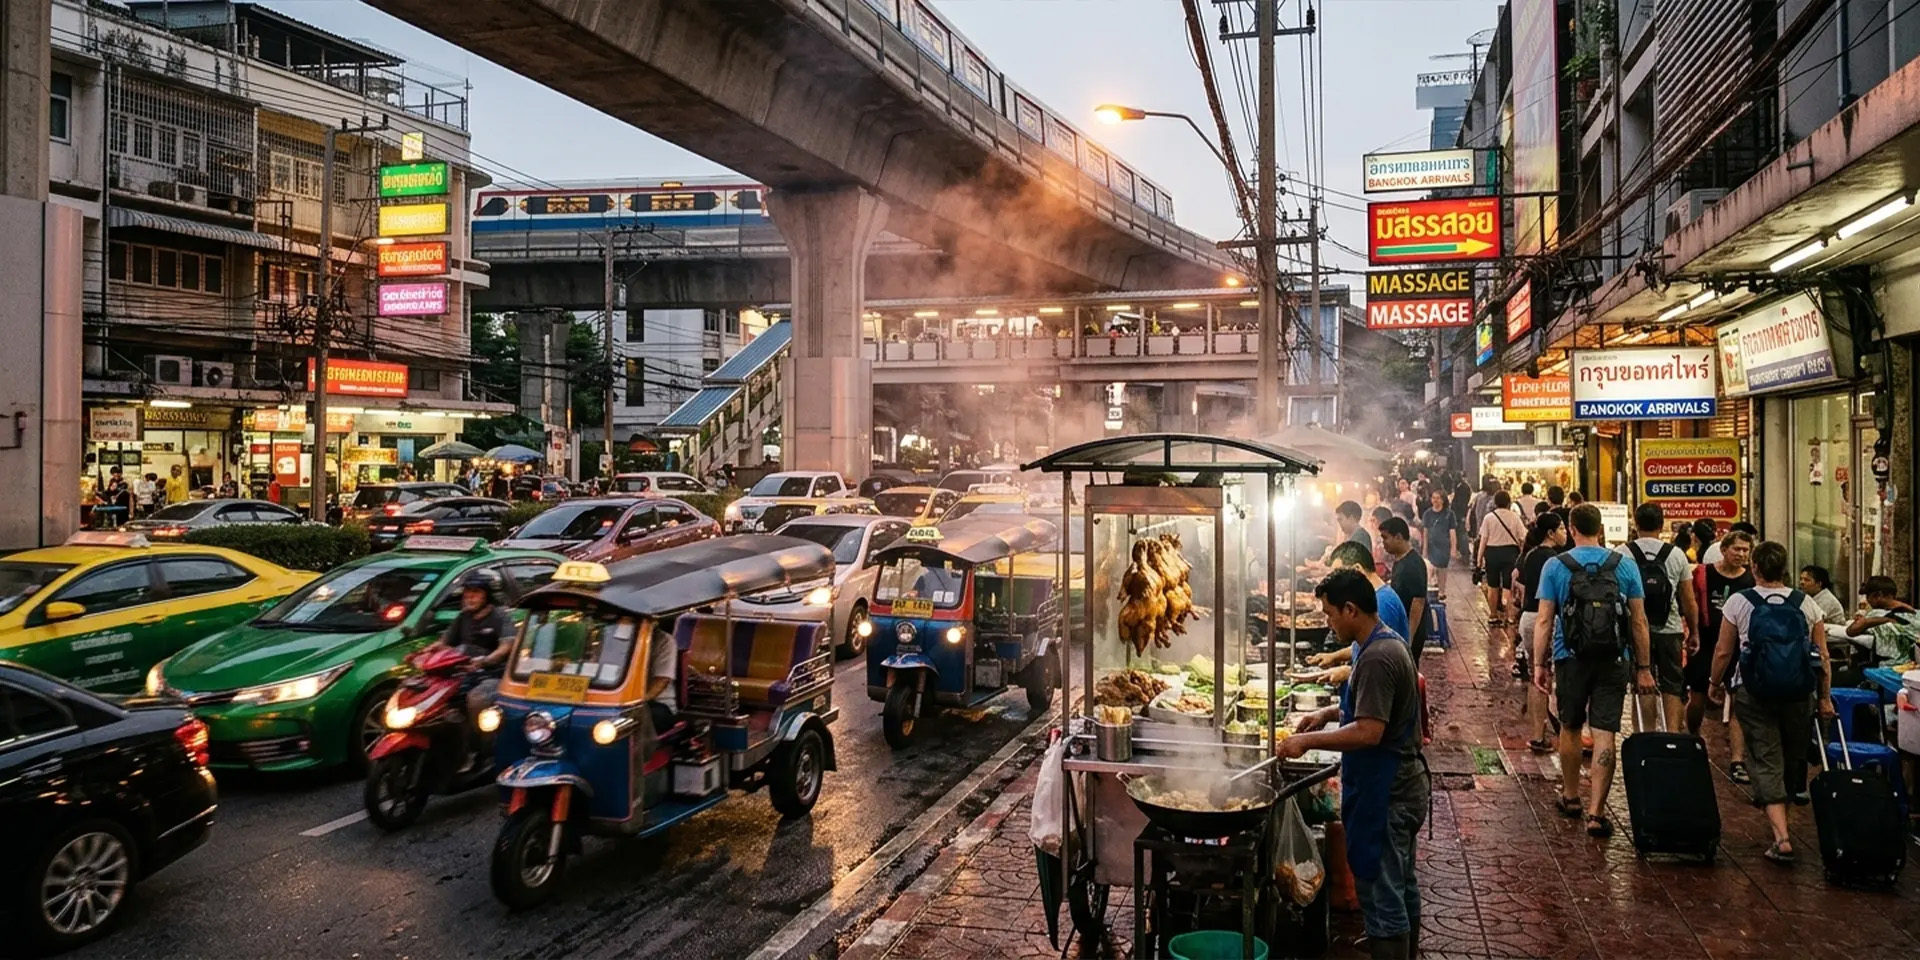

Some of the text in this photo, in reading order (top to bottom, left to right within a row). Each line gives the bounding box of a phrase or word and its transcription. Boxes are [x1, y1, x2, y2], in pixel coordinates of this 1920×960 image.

[1368, 173, 1470, 188] BANGKOK ARRIVALS
[1370, 271, 1470, 294] MASSAGE
[1371, 302, 1469, 325] MASSAGE
[1646, 402, 1710, 414] ARRIVALS
[1652, 483, 1695, 493] STREET
